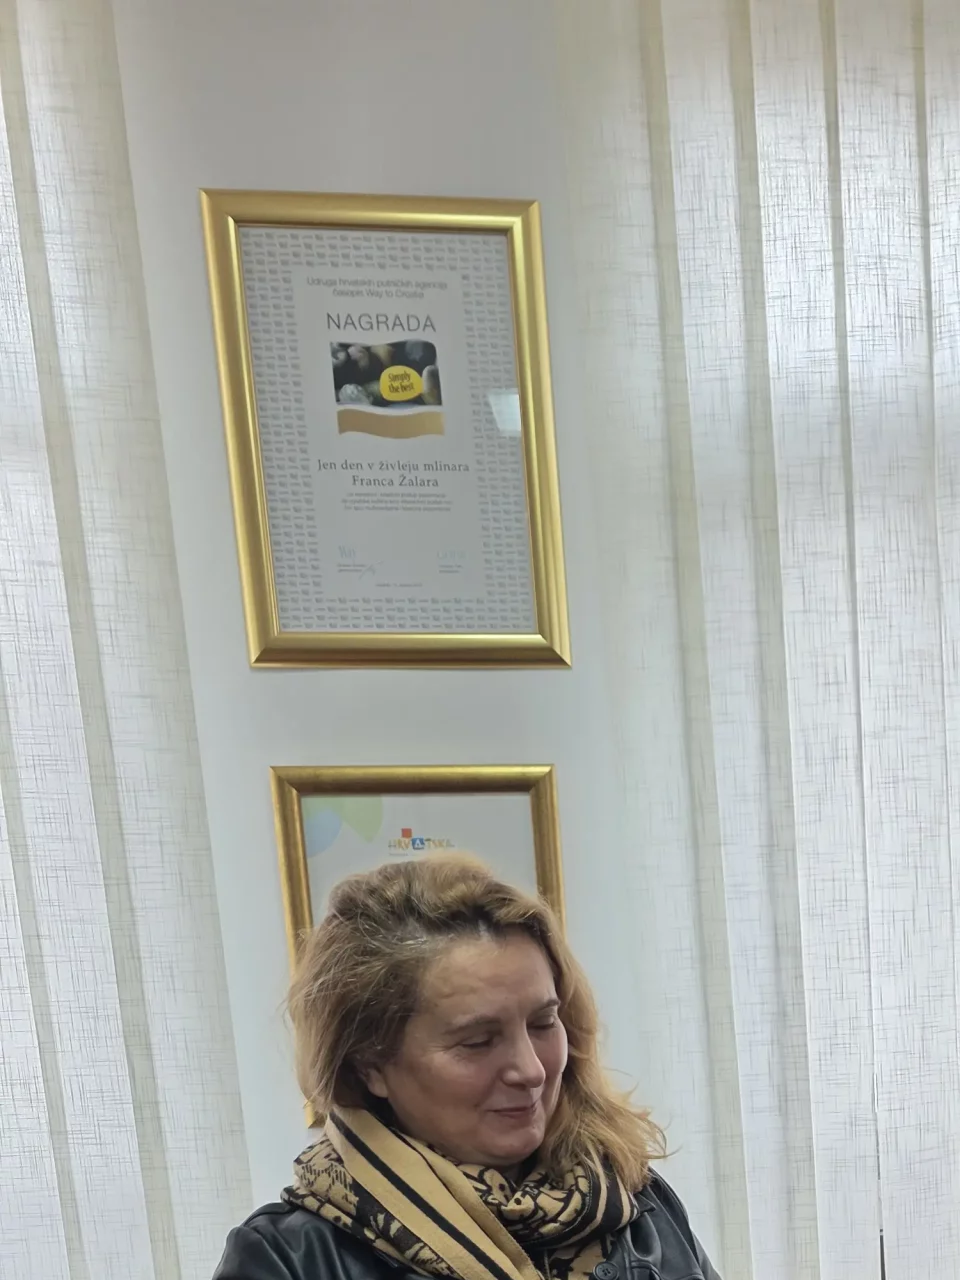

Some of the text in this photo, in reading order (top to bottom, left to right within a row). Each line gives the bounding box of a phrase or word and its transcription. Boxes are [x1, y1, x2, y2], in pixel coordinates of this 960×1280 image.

[365, 288, 383, 299] Way
[384, 289, 394, 298] to
[326, 312, 437, 332] NAGRADA
[317, 459, 470, 474] Jen den v živleju mlinara
[352, 474, 439, 488] Franca Žalara
